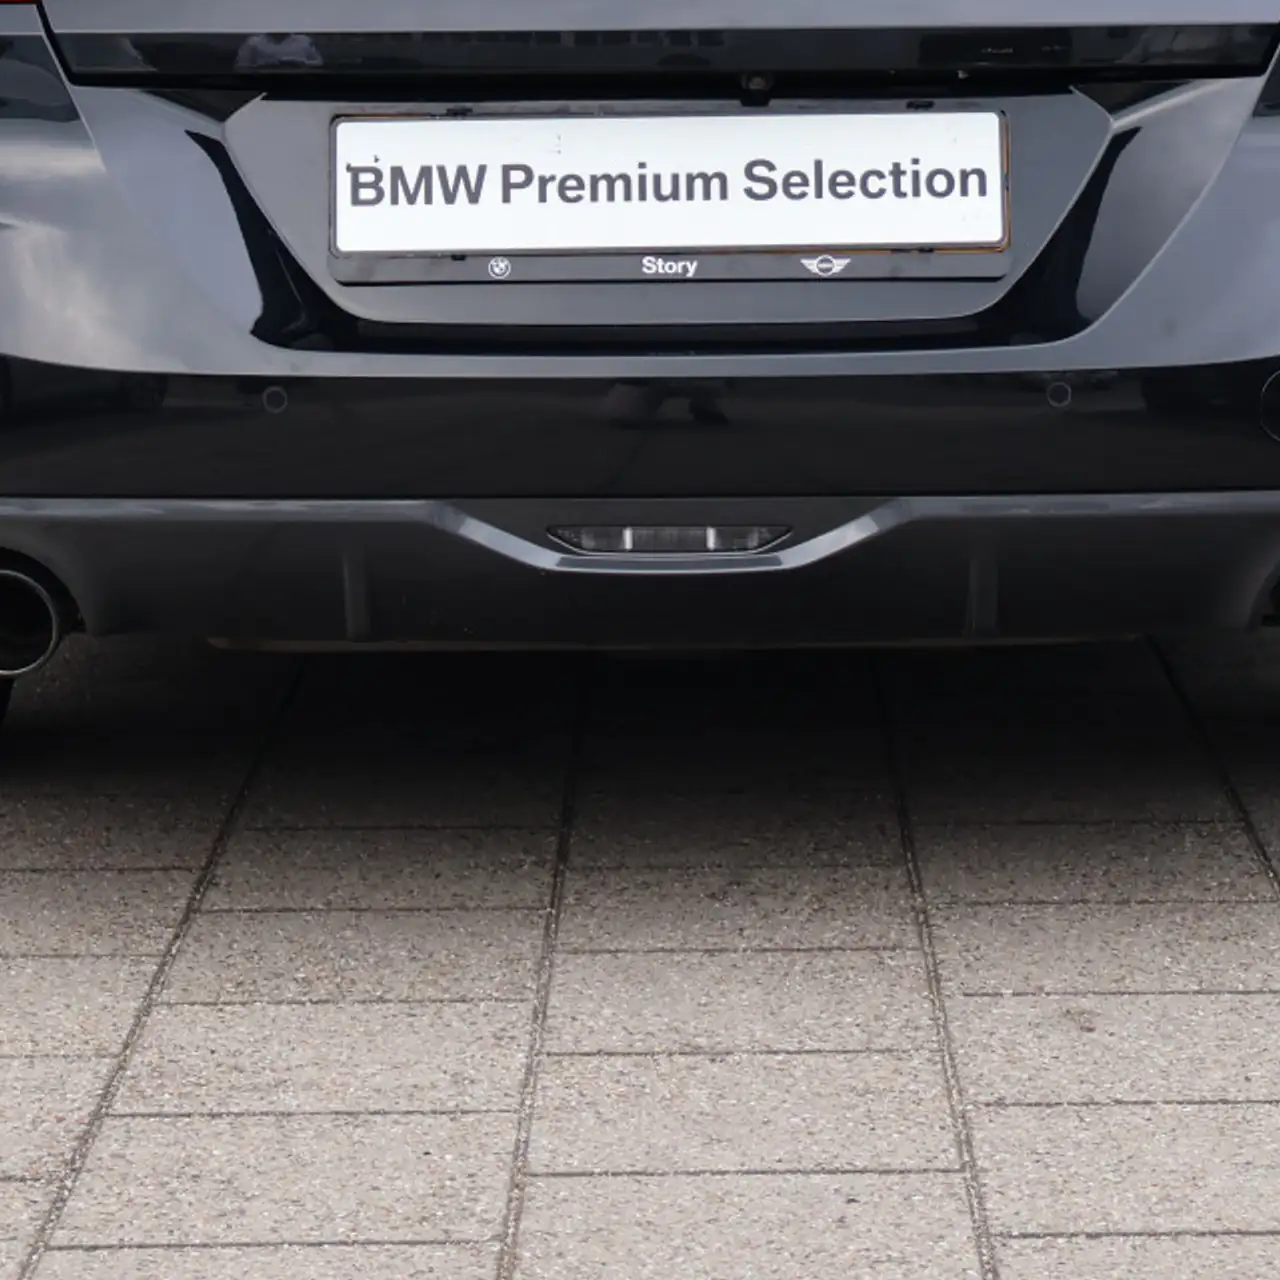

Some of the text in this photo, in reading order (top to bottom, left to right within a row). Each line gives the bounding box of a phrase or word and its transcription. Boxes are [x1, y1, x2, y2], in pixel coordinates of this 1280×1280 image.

[348, 158, 988, 207] BMW Premium Selection
[641, 256, 698, 277] Story
